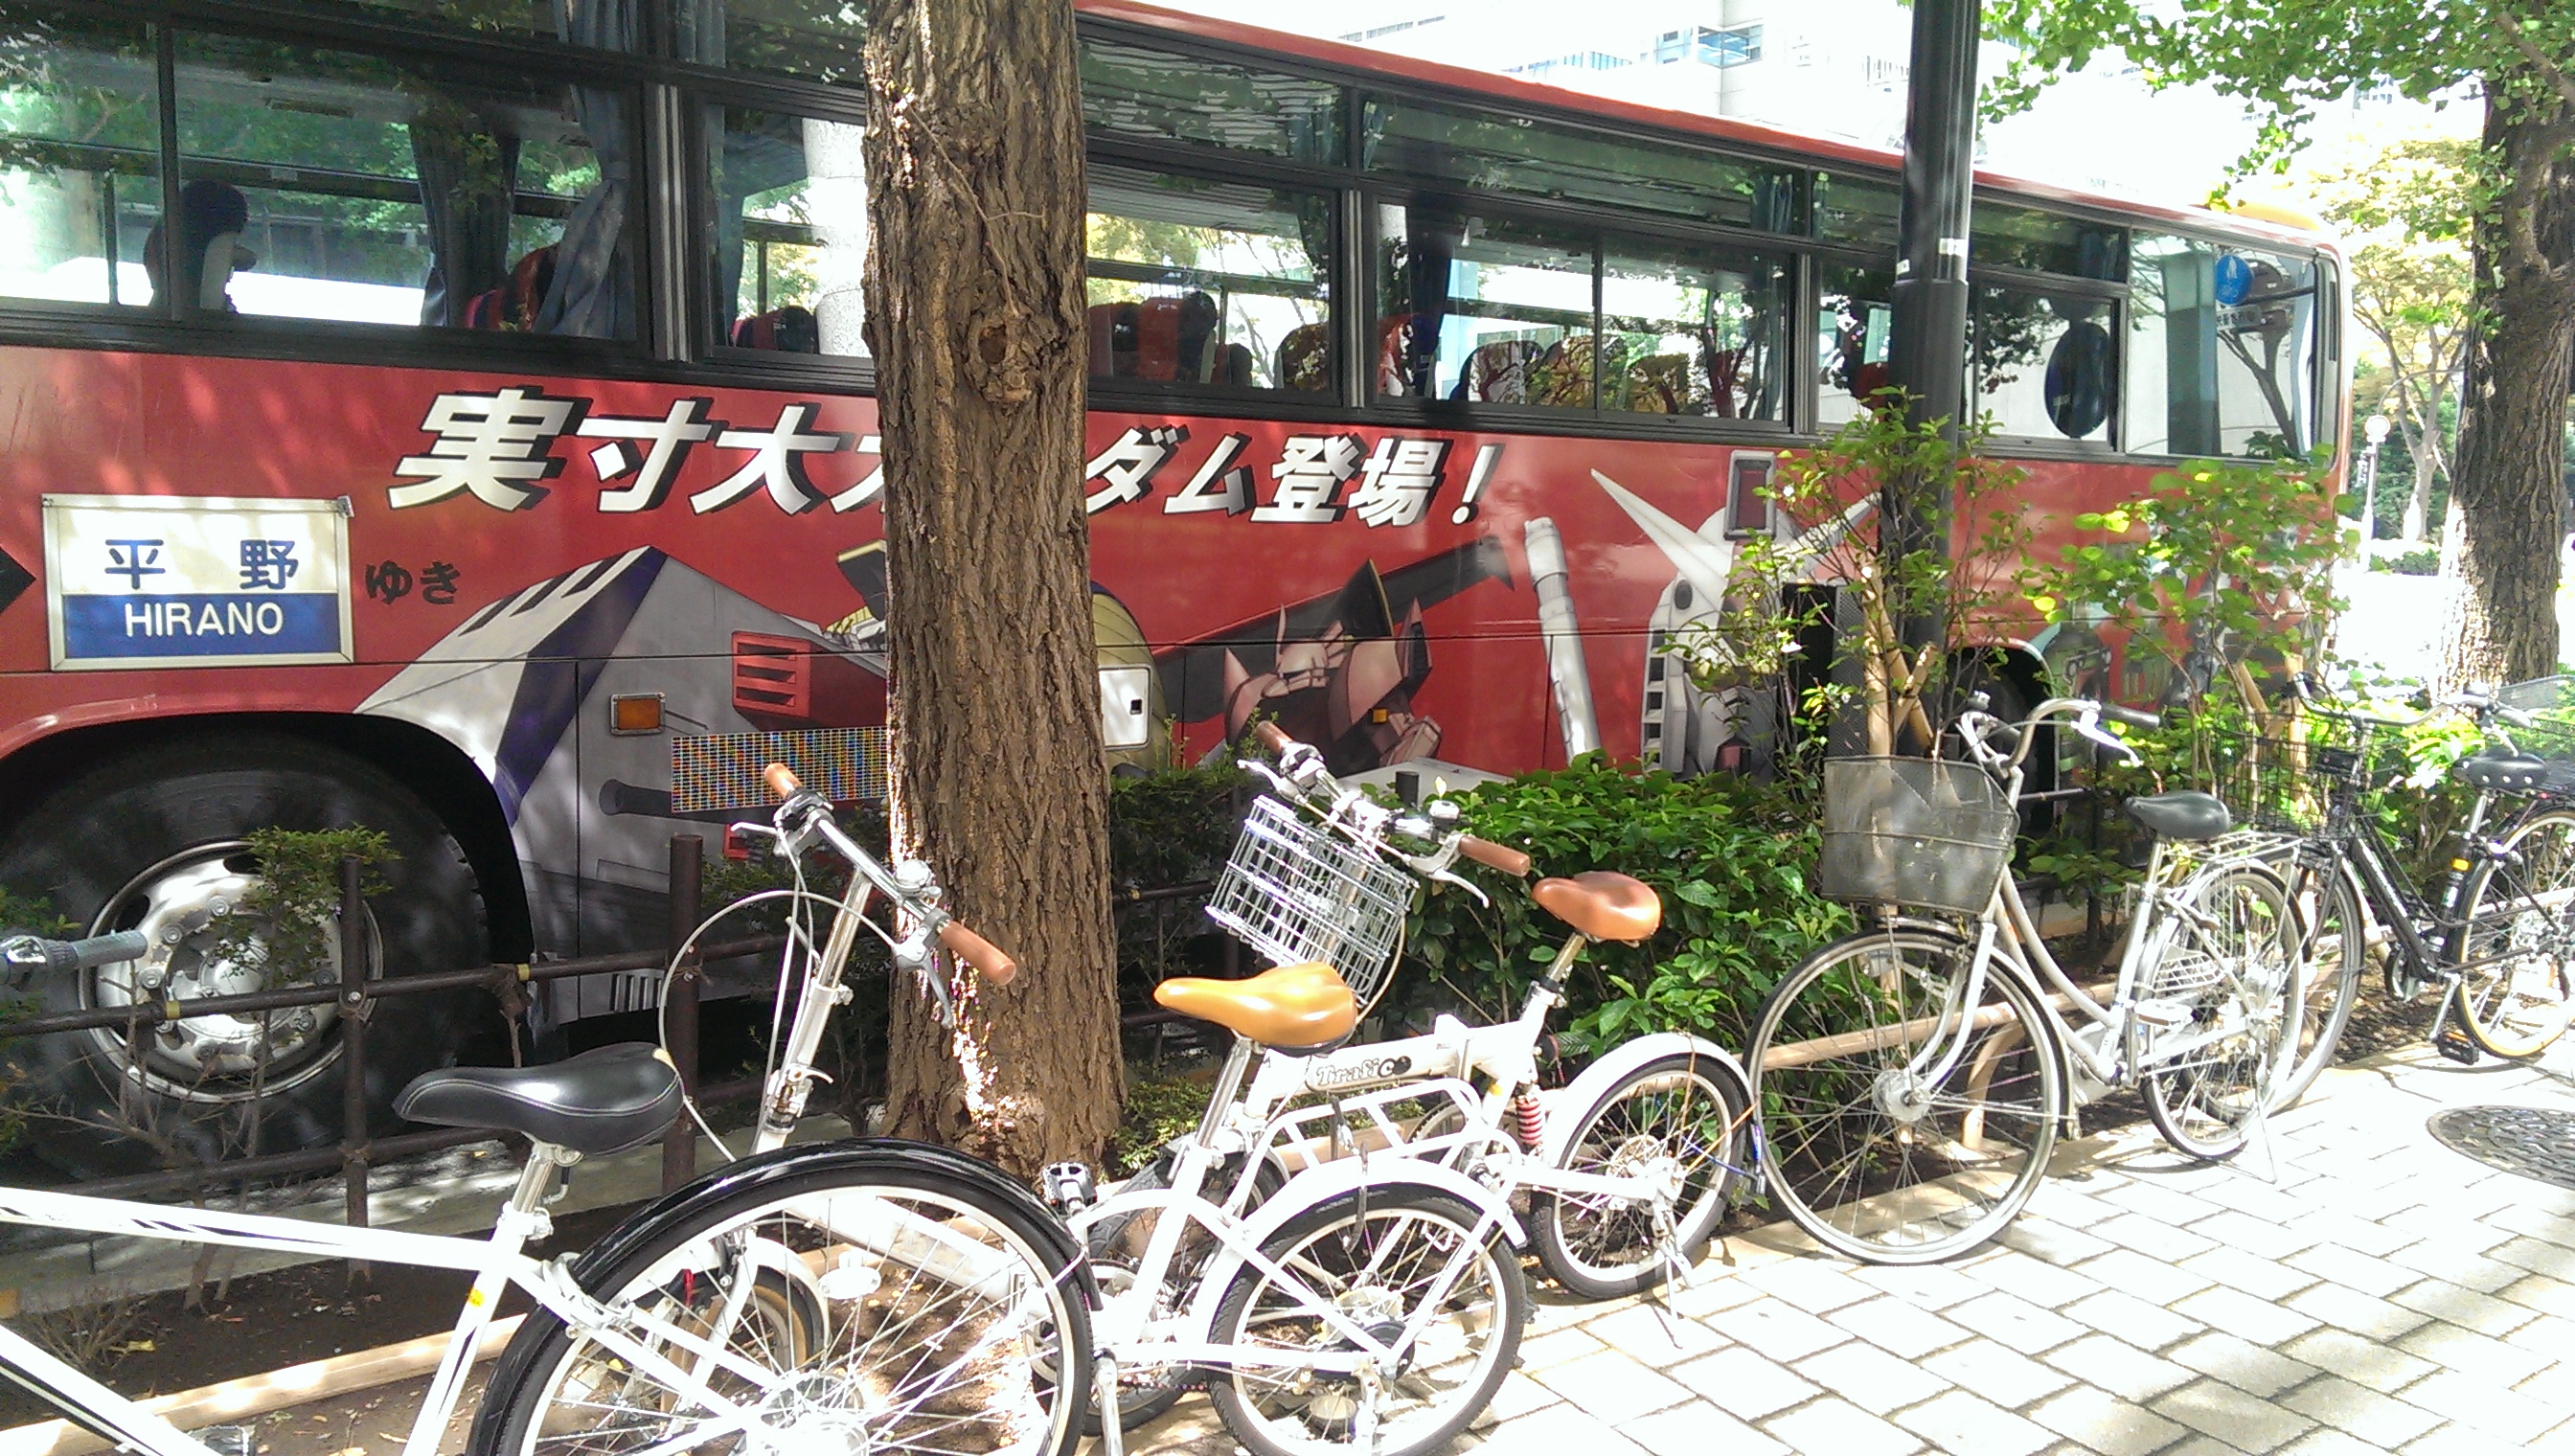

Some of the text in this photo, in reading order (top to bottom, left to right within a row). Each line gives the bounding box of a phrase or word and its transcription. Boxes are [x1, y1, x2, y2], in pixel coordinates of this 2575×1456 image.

[104, 539, 299, 590] 平野
[365, 560, 461, 605] ゆき
[125, 602, 285, 637] HIRANO
